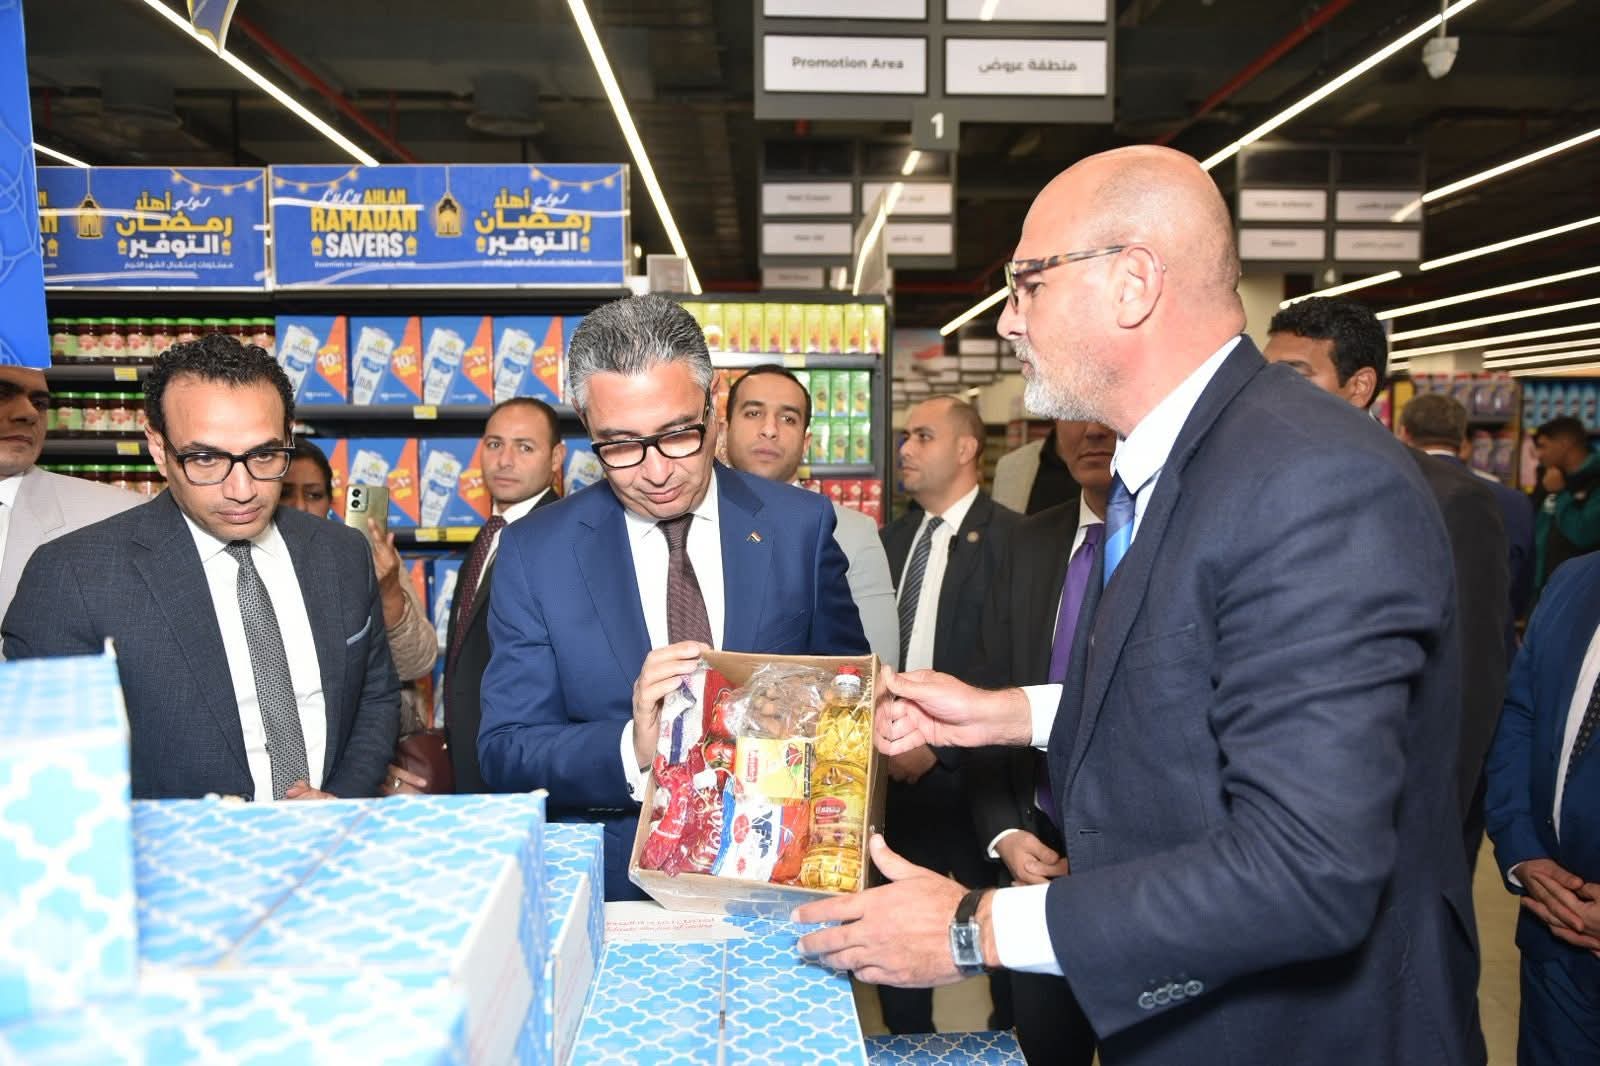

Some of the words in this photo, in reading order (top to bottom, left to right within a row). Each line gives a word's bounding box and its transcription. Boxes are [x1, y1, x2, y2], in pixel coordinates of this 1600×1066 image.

[791, 55, 867, 70] Promotion
[871, 57, 904, 70] Area
[977, 55, 1025, 74] عروض
[1027, 58, 1077, 71] منطقة
[930, 112, 945, 140] 1
[362, 187, 407, 207] AHLAN
[115, 211, 233, 238] رمضان
[310, 206, 417, 232] RAMADAN
[473, 208, 592, 235] رمضان
[128, 233, 219, 259] التوفير
[325, 231, 404, 258] SAVERS
[487, 229, 578, 257] التوفير
